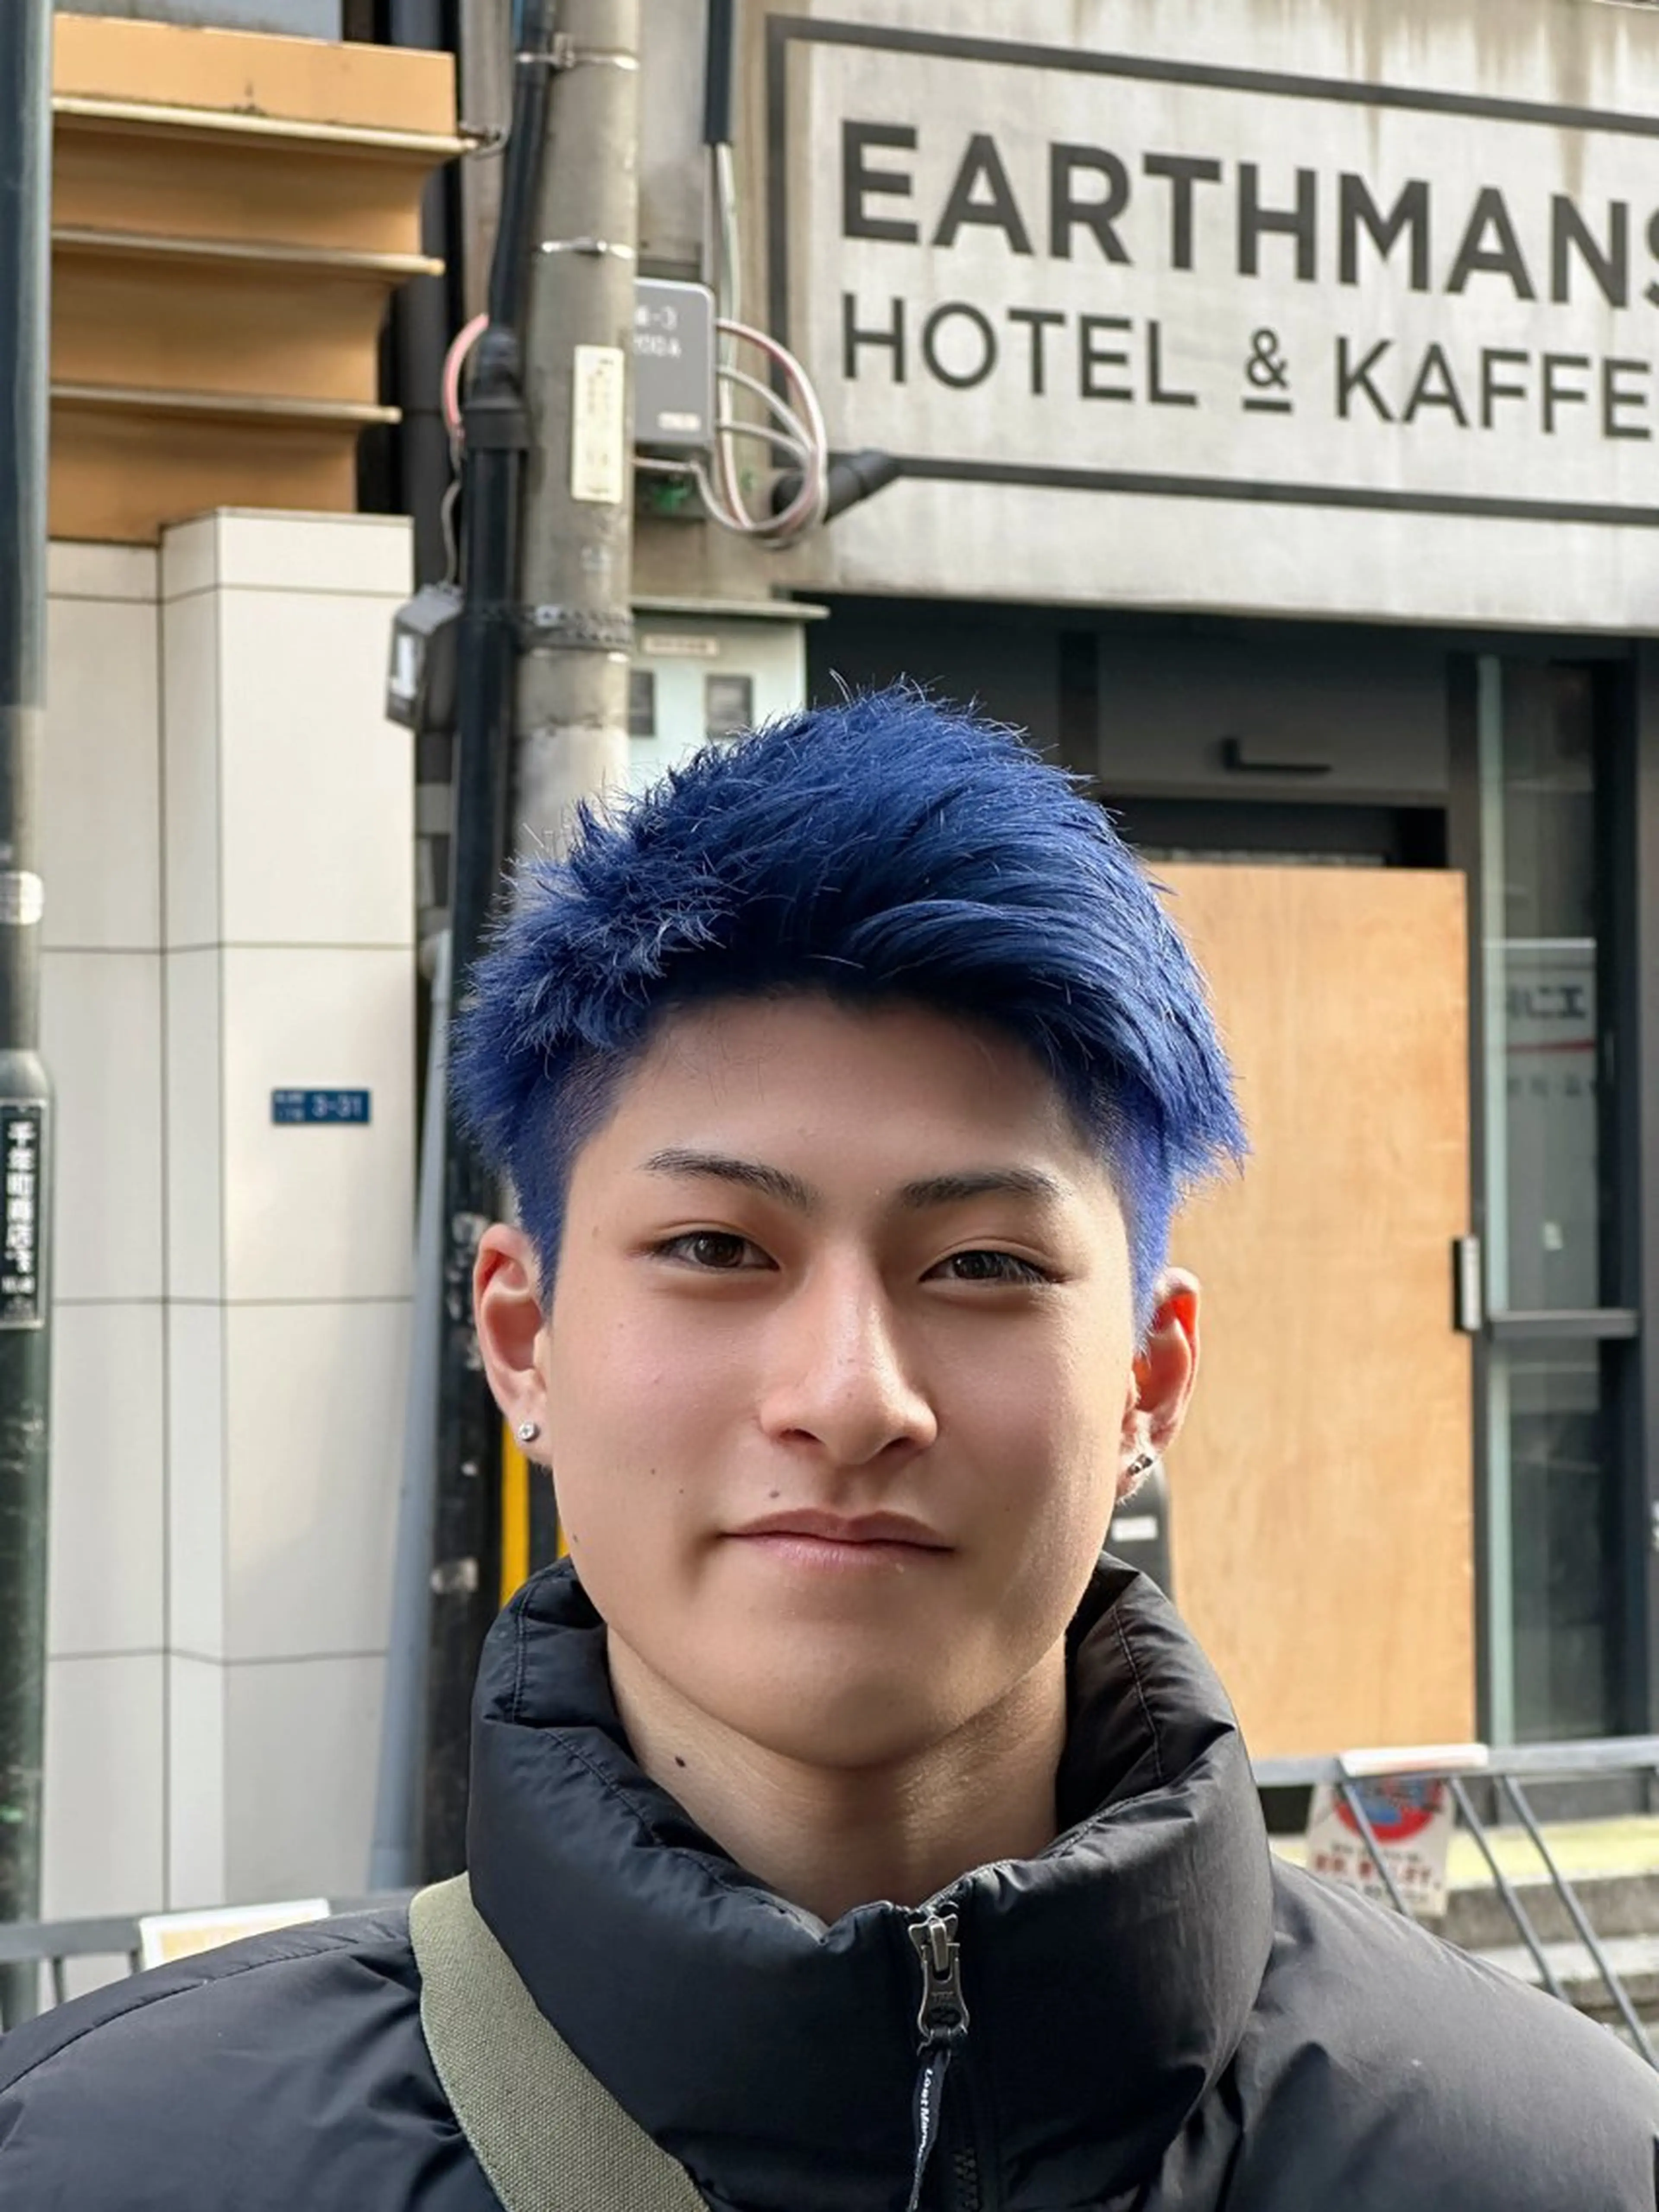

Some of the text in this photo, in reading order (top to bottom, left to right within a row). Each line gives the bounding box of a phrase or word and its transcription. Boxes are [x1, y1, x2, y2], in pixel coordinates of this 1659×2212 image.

[842, 119, 1659, 310] EARTHMAN
[843, 293, 1650, 439] HOTEL & KAFFE
